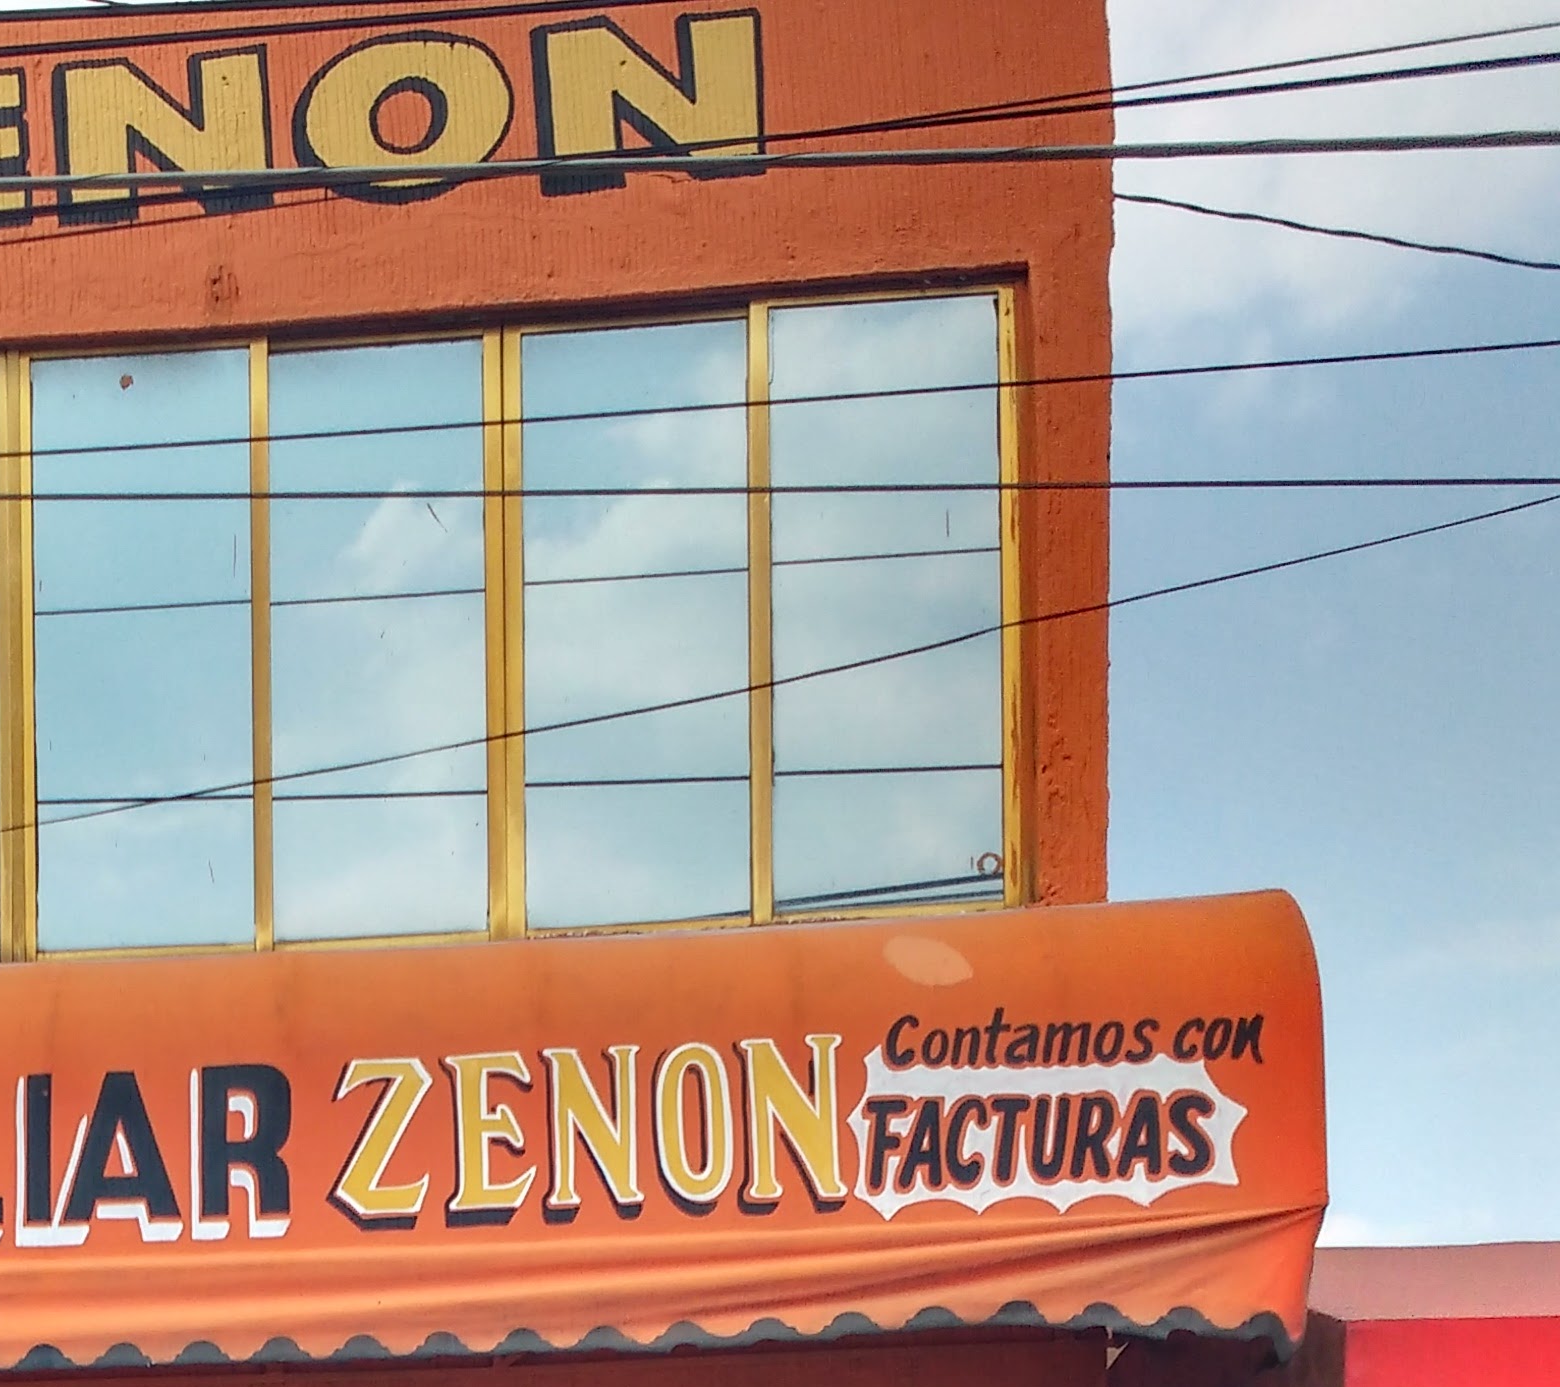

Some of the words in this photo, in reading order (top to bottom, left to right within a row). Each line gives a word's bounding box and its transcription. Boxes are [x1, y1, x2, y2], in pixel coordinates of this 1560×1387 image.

[886, 1007, 1160, 1067] Contamos
[1173, 1013, 1264, 1064] con
[327, 1032, 851, 1231] ZENON
[866, 1093, 1214, 1189] FACTURAS
